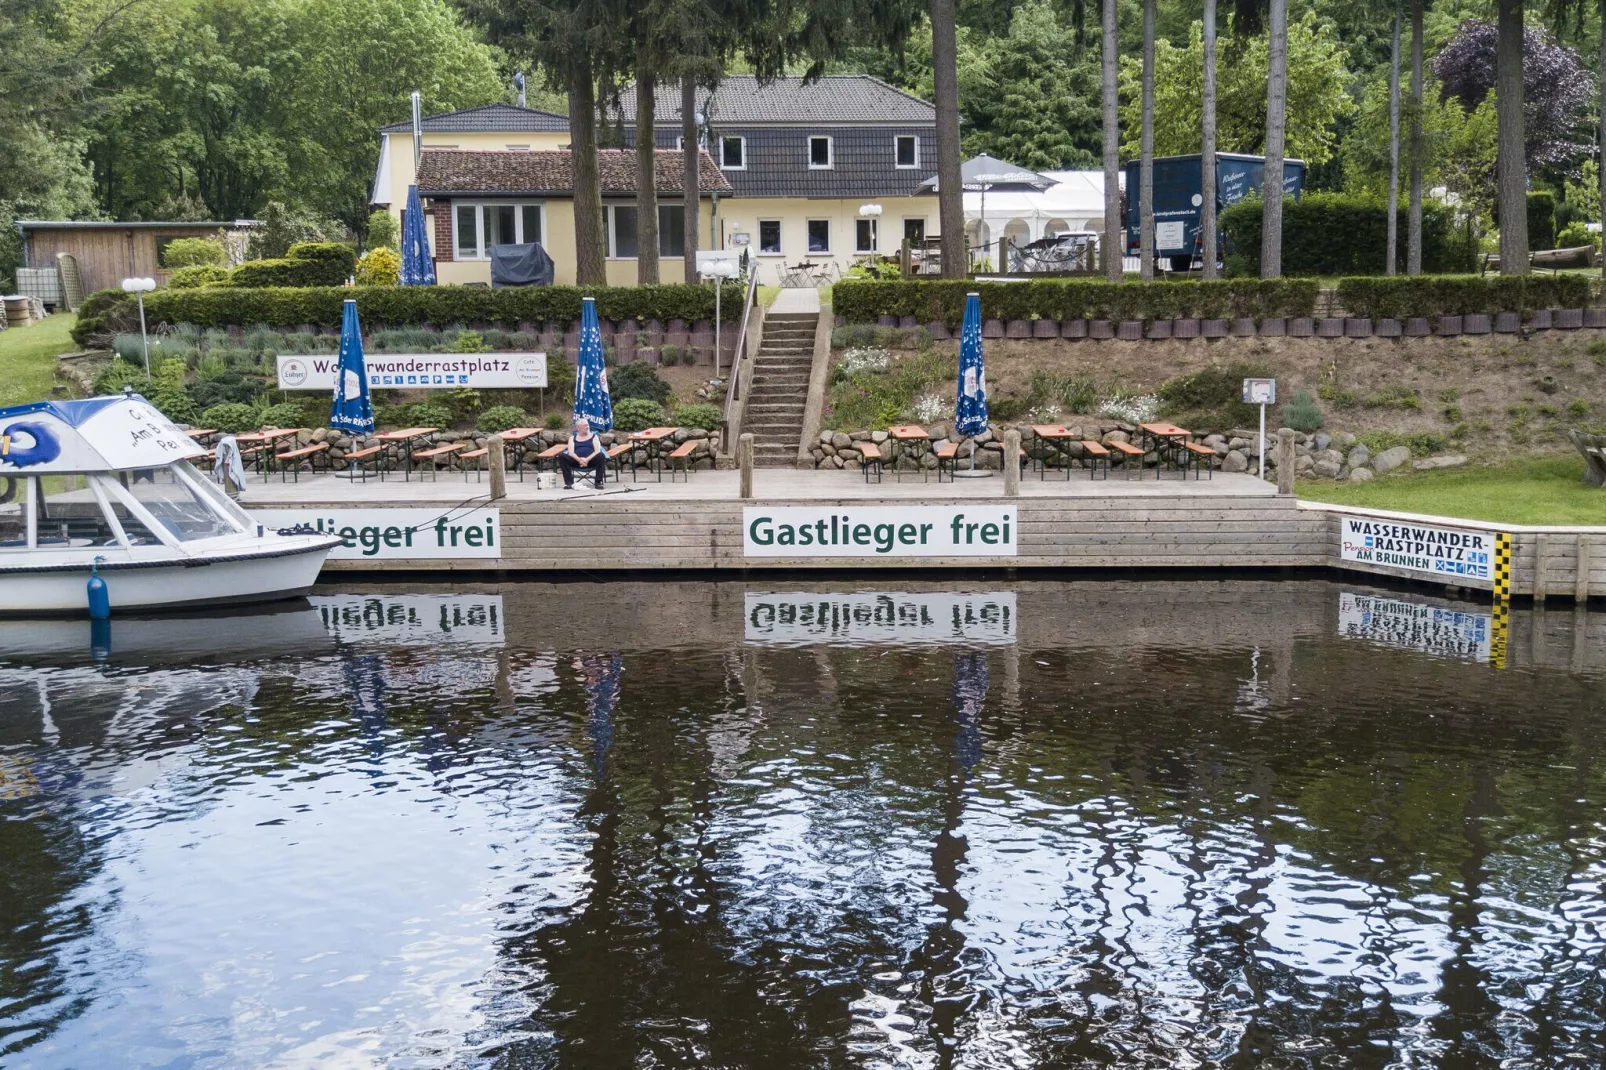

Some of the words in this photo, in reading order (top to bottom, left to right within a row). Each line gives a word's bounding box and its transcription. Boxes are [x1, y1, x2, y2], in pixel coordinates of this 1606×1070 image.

[313, 358, 510, 376] Warwanderrastplatz
[435, 516, 494, 547] frei
[749, 515, 933, 553] Gastlieger
[950, 513, 1010, 545] frei
[1349, 520, 1489, 550] WASSERWANDER-
[1343, 541, 1376, 552] Pension
[1375, 537, 1465, 561] RASTPLATZ
[1356, 550, 1373, 561] AM
[1376, 551, 1430, 569] BRUNNEN
